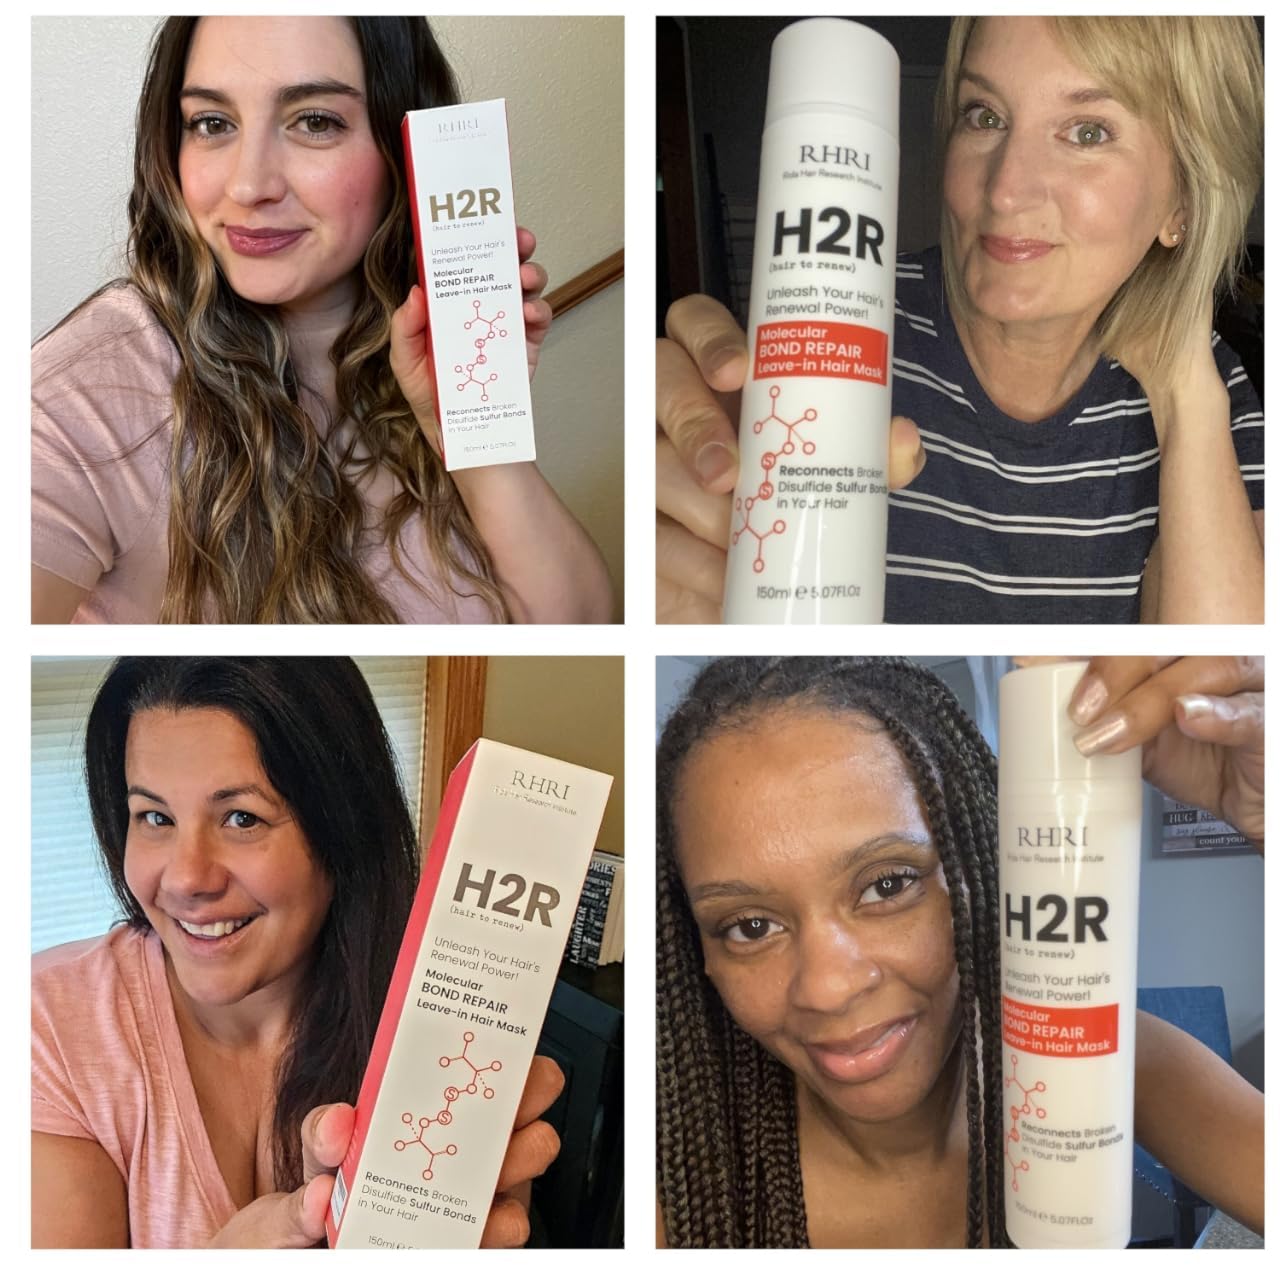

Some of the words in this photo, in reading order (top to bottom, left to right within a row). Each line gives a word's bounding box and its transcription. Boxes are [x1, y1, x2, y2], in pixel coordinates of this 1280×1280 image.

[800, 145, 870, 171] RHRI
[430, 188, 502, 222] H2R
[773, 206, 884, 266] H2R
[434, 267, 473, 278] Molecular
[435, 278, 461, 288] BOND
[463, 274, 495, 285] REPAIR
[436, 288, 471, 299] Leave-in
[473, 286, 489, 294] Hair
[491, 282, 512, 292] Mask
[767, 285, 818, 301] Unleash
[822, 286, 853, 300] Your
[857, 291, 884, 309] Hair's
[766, 302, 820, 317] Renewal
[825, 304, 868, 320] Power!
[759, 343, 801, 358] BOND
[805, 342, 862, 359] REPAIR
[820, 359, 850, 373] Hair
[447, 406, 490, 416] Reconnects
[779, 465, 854, 477] Reconnects
[836, 482, 867, 493] Sulfur
[512, 770, 571, 800] RHRI
[1169, 813, 1193, 823] HUG
[1018, 826, 1088, 847] RHRI
[1200, 836, 1224, 845] count
[452, 863, 561, 928] H2R
[1005, 893, 1109, 943] H2R
[434, 936, 480, 957] Unleash
[483, 949, 508, 965] Your
[510, 956, 541, 973] Hair's
[431, 950, 478, 971] Renewal
[481, 964, 520, 982] Power!
[425, 968, 483, 992] Molecular
[1044, 975, 1074, 986] Your
[1078, 973, 1110, 986] Hair's
[421, 983, 460, 1002] BOND
[462, 994, 508, 1015] REPAIR
[1047, 990, 1091, 1002] Power!
[416, 999, 468, 1019] Leave-in
[470, 1012, 494, 1027] Hair
[496, 1019, 527, 1036] Mask
[1032, 1026, 1084, 1039] REPAIR
[1046, 1041, 1074, 1053] Hair
[1077, 1041, 1110, 1053] Mask
[1065, 1139, 1096, 1150] Sulfur
[365, 1171, 429, 1197] Reconnects
[432, 1191, 468, 1208] Broken
[362, 1184, 407, 1205] Disulfide
[409, 1199, 441, 1214] Sulfur
[443, 1208, 476, 1224] Bonds
[371, 1202, 395, 1217] Your
[397, 1209, 419, 1222] Hair
